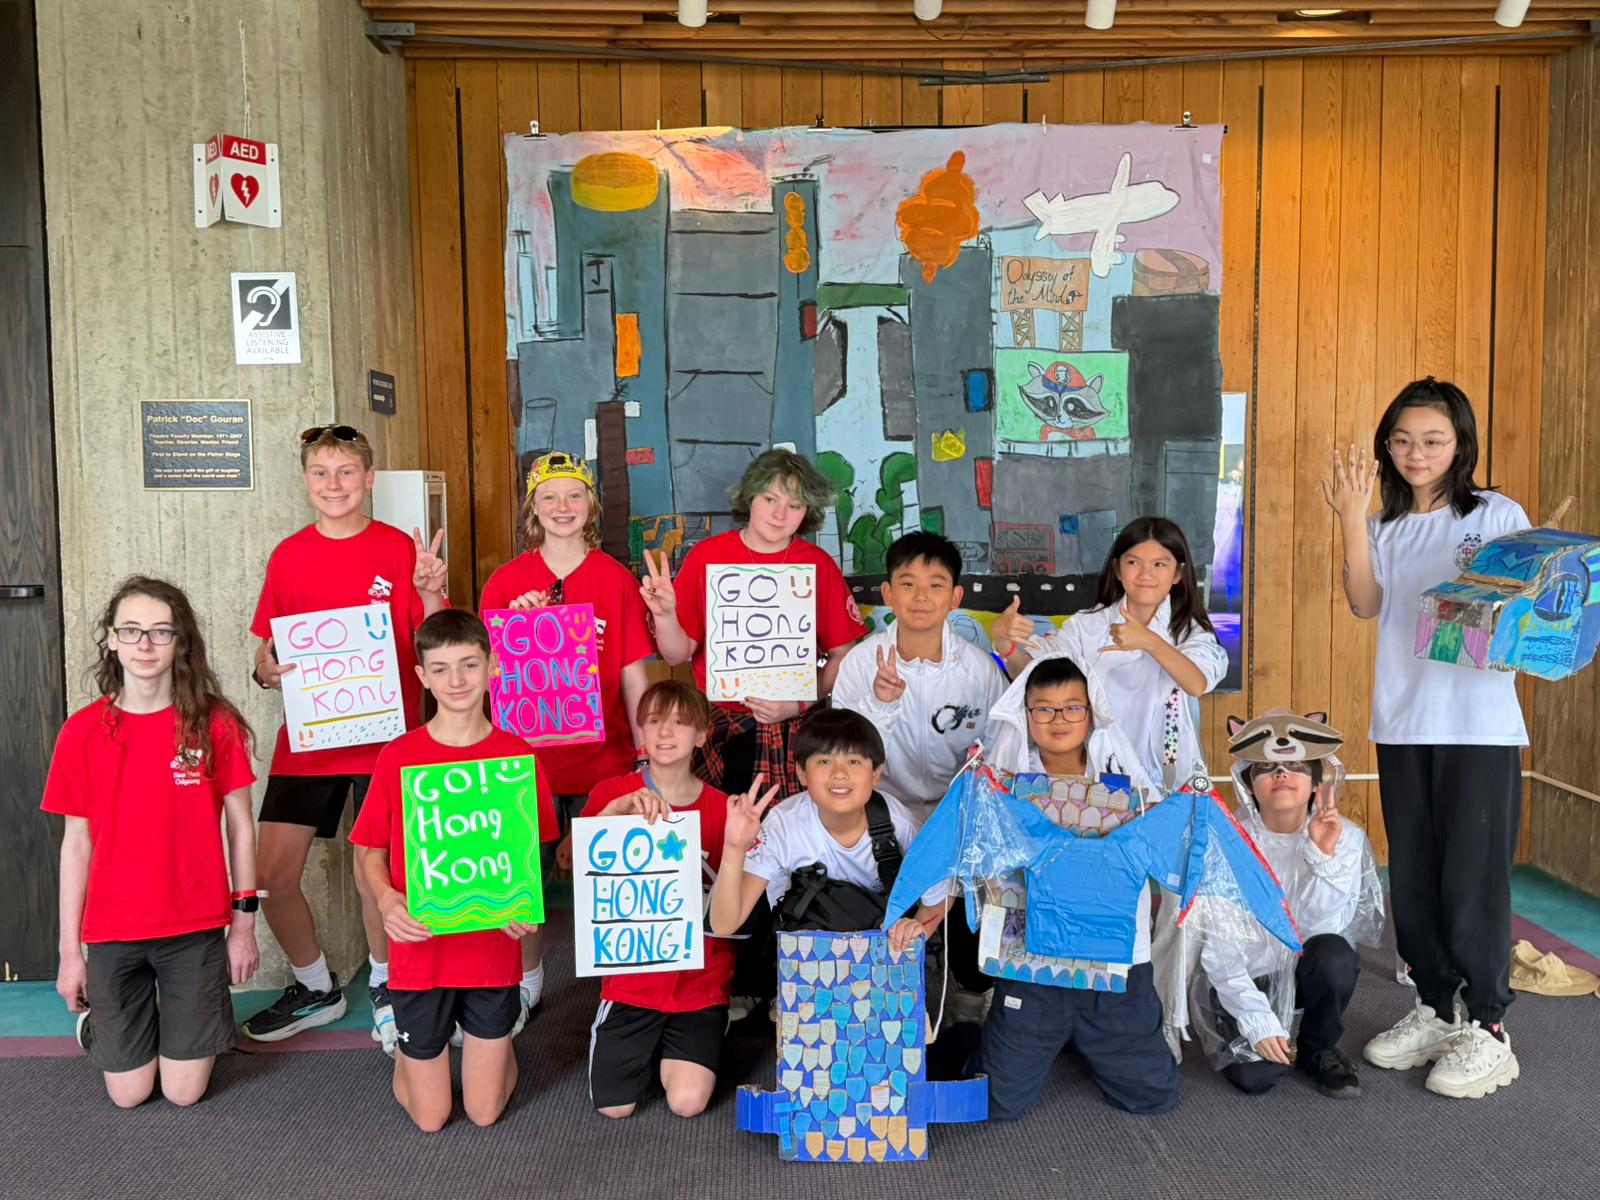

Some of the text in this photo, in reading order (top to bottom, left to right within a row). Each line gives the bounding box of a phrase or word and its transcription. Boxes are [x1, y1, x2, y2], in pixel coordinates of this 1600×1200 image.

[230, 141, 259, 160] AED
[1007, 259, 1076, 294] Odyssey of
[1008, 283, 1068, 304] the Mind
[147, 415, 178, 423] Patrick
[210, 415, 243, 423] Gouran
[718, 573, 777, 603] GO
[288, 618, 348, 650] GO
[503, 612, 564, 655] GO
[500, 657, 593, 695] HONG
[498, 693, 603, 736] KONG!
[417, 804, 502, 842] Hong
[420, 847, 512, 890] Kong
[588, 827, 655, 873] GO
[593, 876, 684, 920] HONG
[593, 921, 694, 964] KONG!
